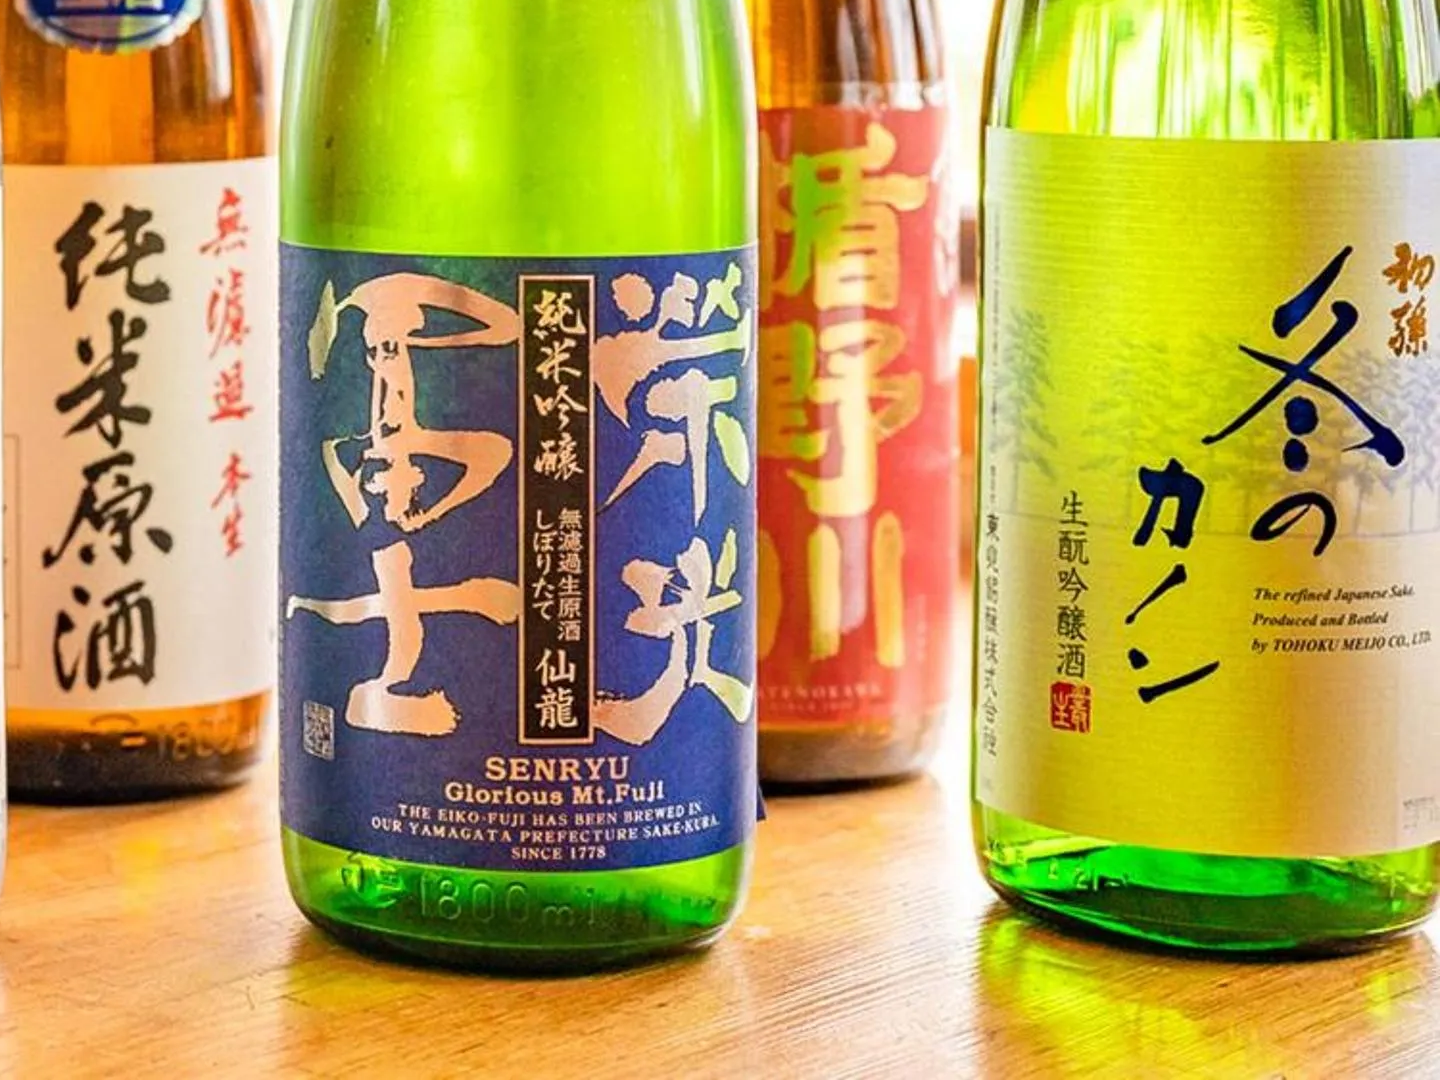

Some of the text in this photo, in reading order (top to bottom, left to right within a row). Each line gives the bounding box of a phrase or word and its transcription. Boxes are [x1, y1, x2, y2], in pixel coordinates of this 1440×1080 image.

[532, 288, 588, 482] 純米吟醸
[1201, 244, 1406, 558] 冬の
[42, 199, 174, 693] 純米原酒
[531, 508, 558, 620] しぼりたて
[557, 506, 583, 642] 無濾過生原酒
[1124, 457, 1221, 706] カノン
[1254, 587, 1282, 602] The
[1283, 588, 1332, 605] refined
[1334, 588, 1388, 605] Japanese
[1252, 611, 1389, 627] Produced and Bottled
[1251, 638, 1269, 655] by
[1273, 638, 1340, 653] TOHOKU
[1342, 636, 1386, 653] MEIJO
[533, 648, 578, 730] 仙龍
[485, 755, 630, 782] SENRYU
[444, 779, 666, 807] Glorious Mt.Fuji
[398, 800, 703, 827] THE EIKO-FUJI HAS BEEN BREWED IN
[371, 815, 403, 834] OUR
[409, 822, 512, 843] YAMAGATA
[519, 827, 639, 843] PREFECTURE
[511, 845, 608, 862] SINCE 1778
